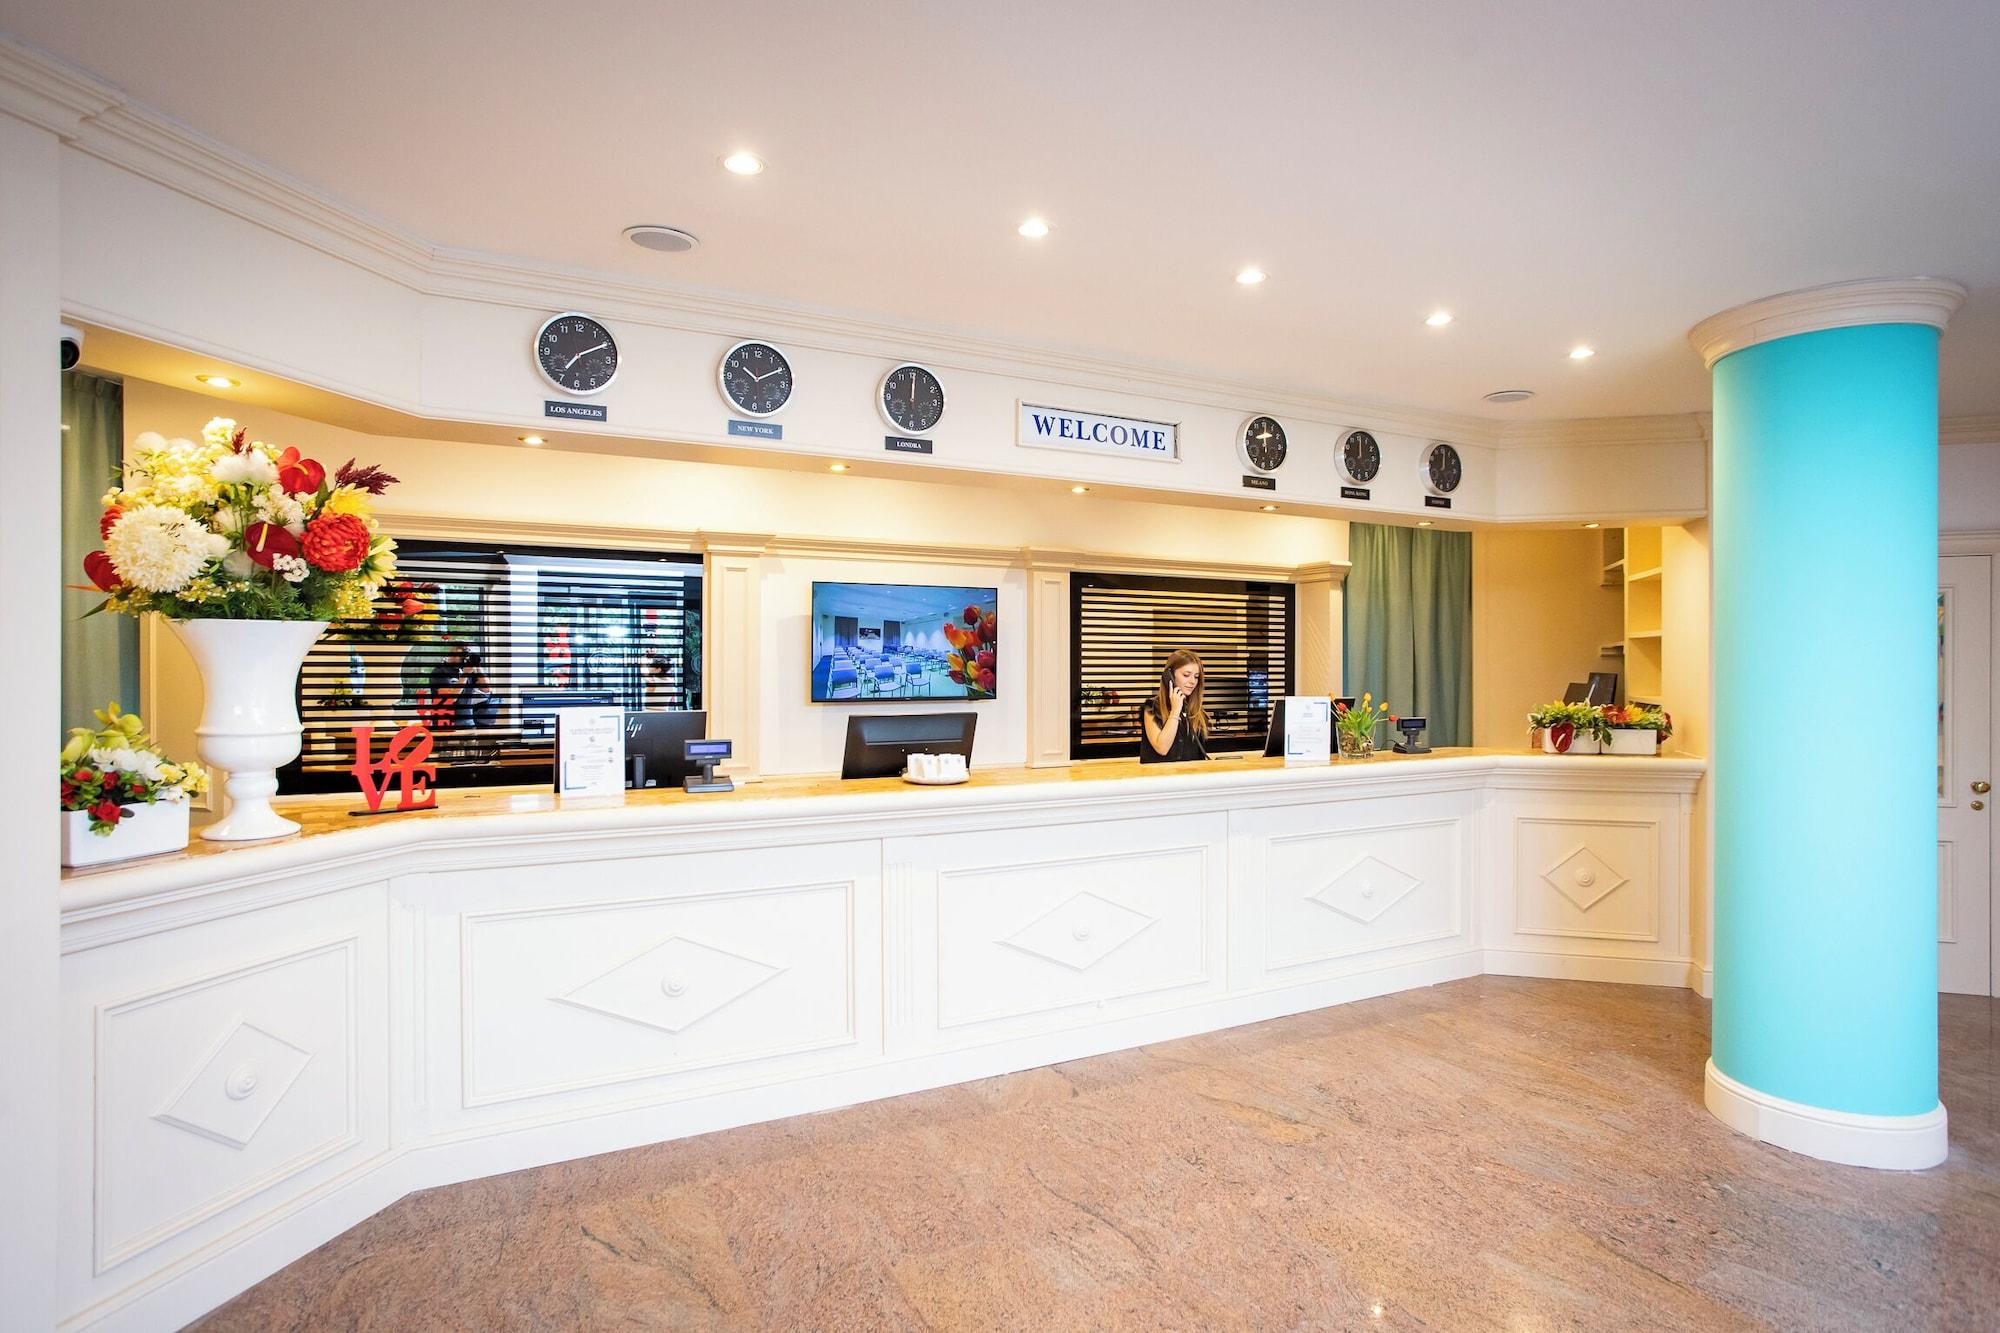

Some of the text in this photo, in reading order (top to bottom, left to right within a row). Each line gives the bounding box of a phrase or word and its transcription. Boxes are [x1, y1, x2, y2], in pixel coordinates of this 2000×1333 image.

[560, 325, 568, 333] 11
[575, 324, 584, 333] 12
[548, 334, 558, 342] 10
[544, 347, 550, 356] 9
[754, 350, 762, 358] 12
[605, 356, 611, 364] 3
[731, 360, 739, 368] 10
[559, 373, 565, 381] 7
[727, 372, 732, 380] 9
[573, 379, 580, 388] 6
[590, 377, 596, 386] 5
[550, 406, 603, 417] LOS ANGELES
[1032, 414, 1166, 450] WELCOME
[896, 441, 922, 449] LONDRA
